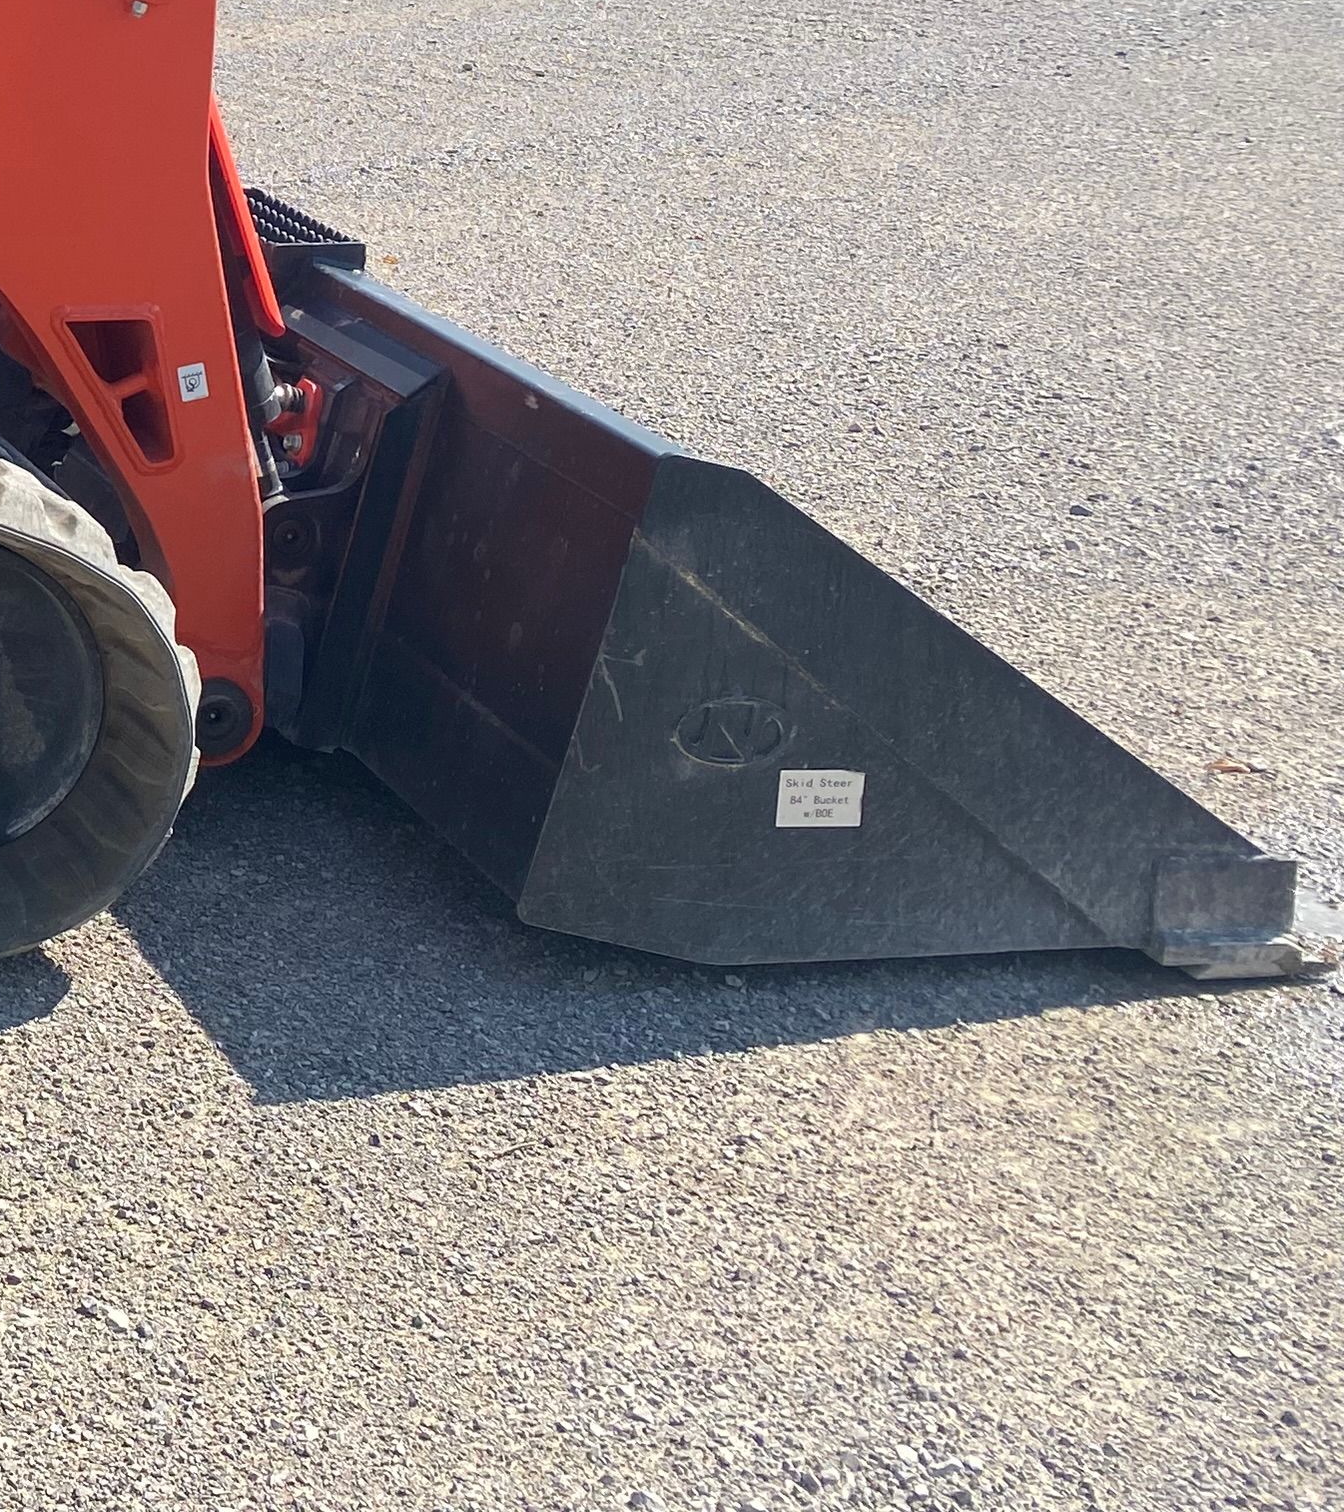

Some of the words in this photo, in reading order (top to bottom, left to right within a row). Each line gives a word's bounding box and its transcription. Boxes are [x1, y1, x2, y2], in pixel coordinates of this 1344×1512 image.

[785, 778, 814, 788] Skid
[819, 778, 853, 788] Steer
[813, 795, 849, 805] Bucket
